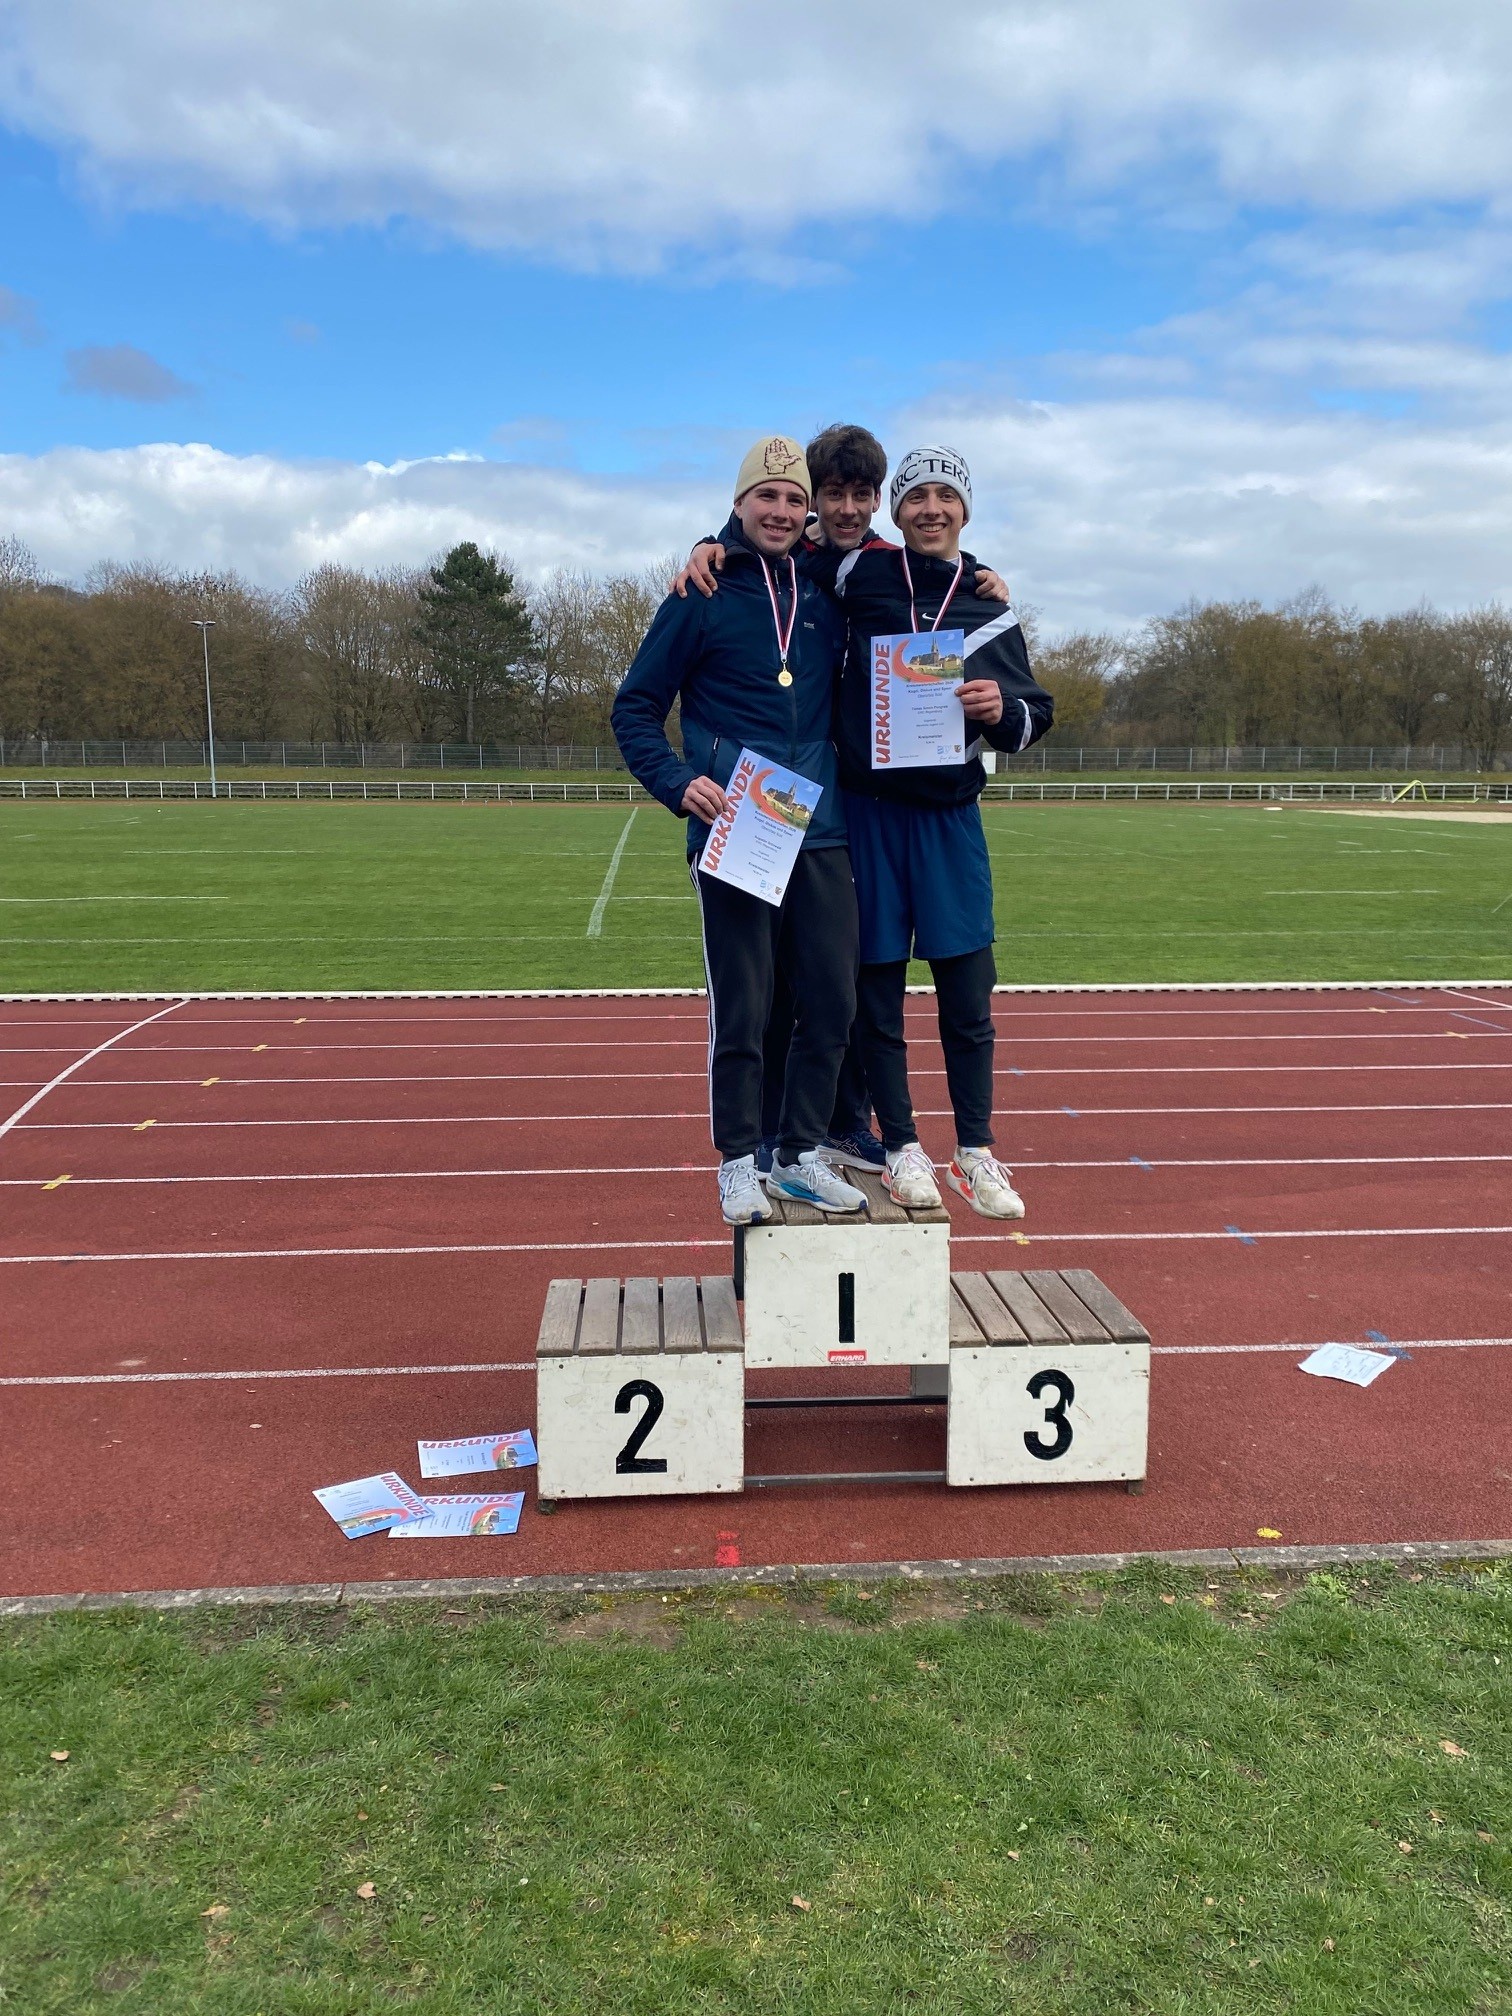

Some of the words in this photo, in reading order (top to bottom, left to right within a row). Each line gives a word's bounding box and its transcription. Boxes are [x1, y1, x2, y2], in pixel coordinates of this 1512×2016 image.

[875, 643, 891, 764] URKUNDE
[704, 757, 757, 872] URKUNDE
[838, 1272, 854, 1343] 1
[422, 1432, 524, 1449] URKUNDE
[615, 1378, 668, 1474] 2
[1024, 1370, 1075, 1461] 3
[380, 1474, 430, 1517] URKUNDE
[420, 1494, 517, 1505] RKUNDE
